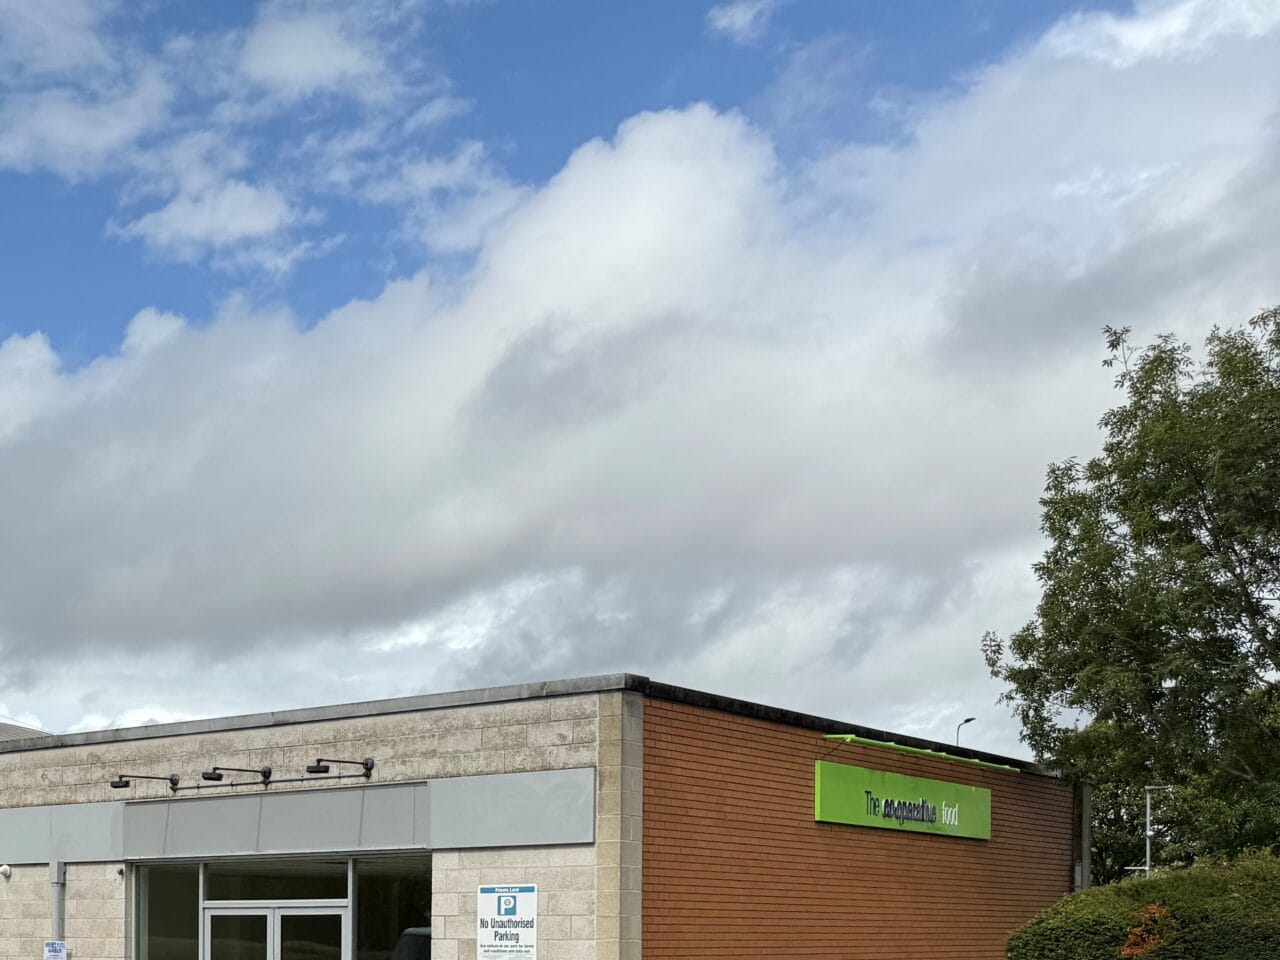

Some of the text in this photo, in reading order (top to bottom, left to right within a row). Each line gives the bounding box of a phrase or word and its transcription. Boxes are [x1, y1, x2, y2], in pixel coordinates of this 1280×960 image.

[865, 791, 959, 826] The co-operative food
[480, 917, 534, 929] No Unauthorised
[494, 930, 519, 943] Parking
